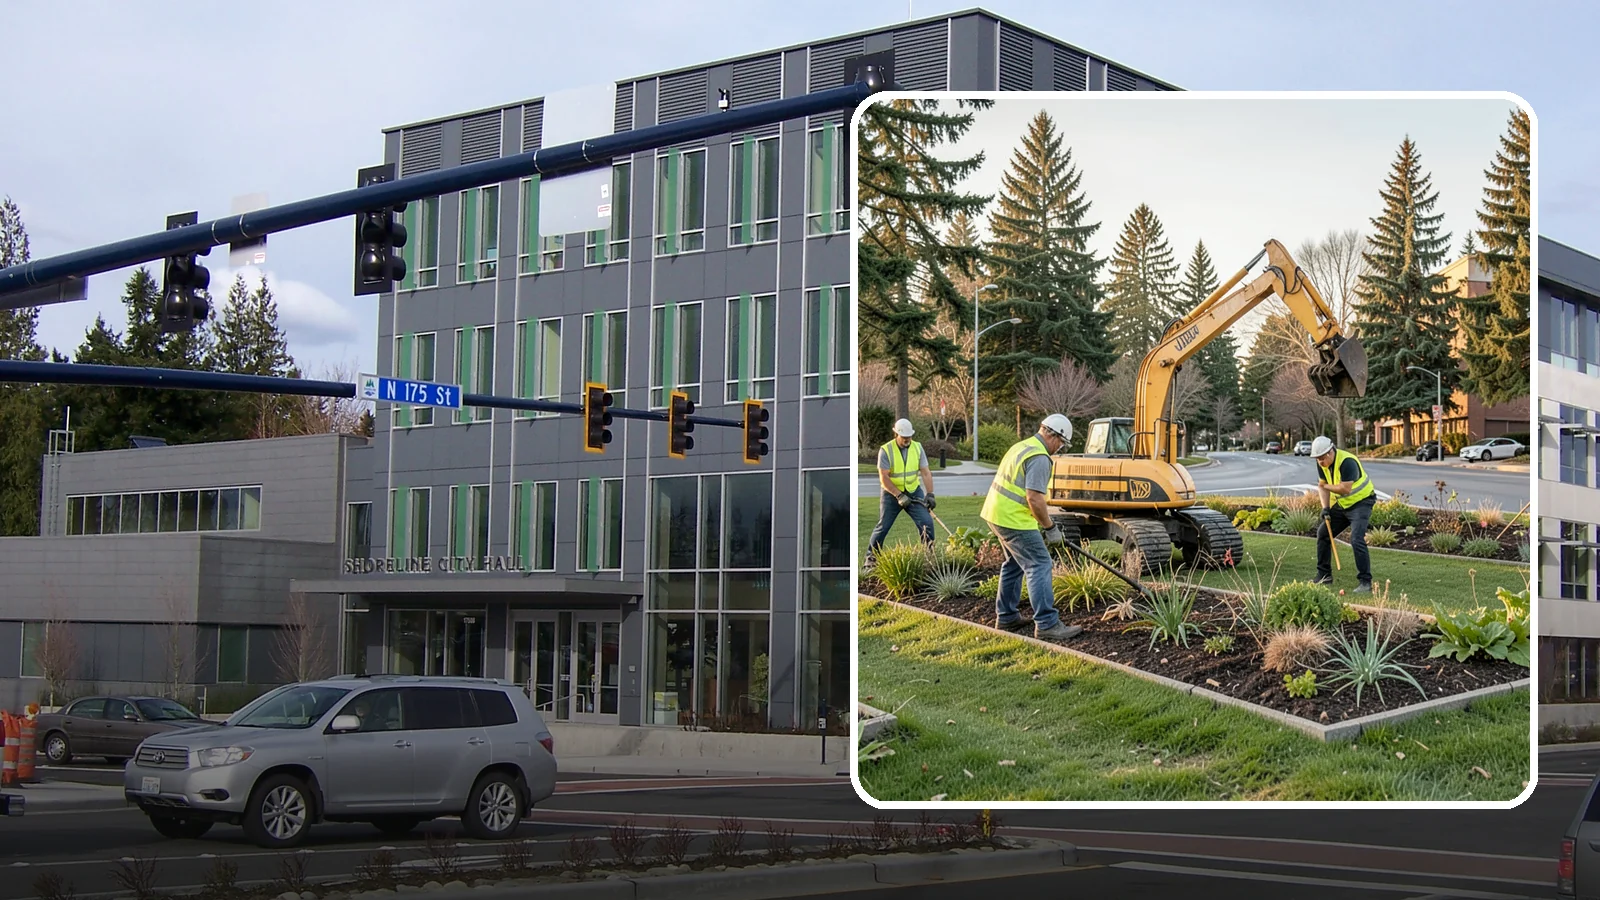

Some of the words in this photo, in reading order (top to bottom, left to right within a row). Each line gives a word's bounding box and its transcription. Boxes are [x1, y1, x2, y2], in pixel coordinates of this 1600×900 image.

[387, 380, 396, 400] N
[405, 382, 428, 403] 175
[435, 386, 452, 406] St
[343, 557, 432, 575] SHORELINE
[438, 556, 475, 573] CITY
[484, 556, 526, 573] HALL
